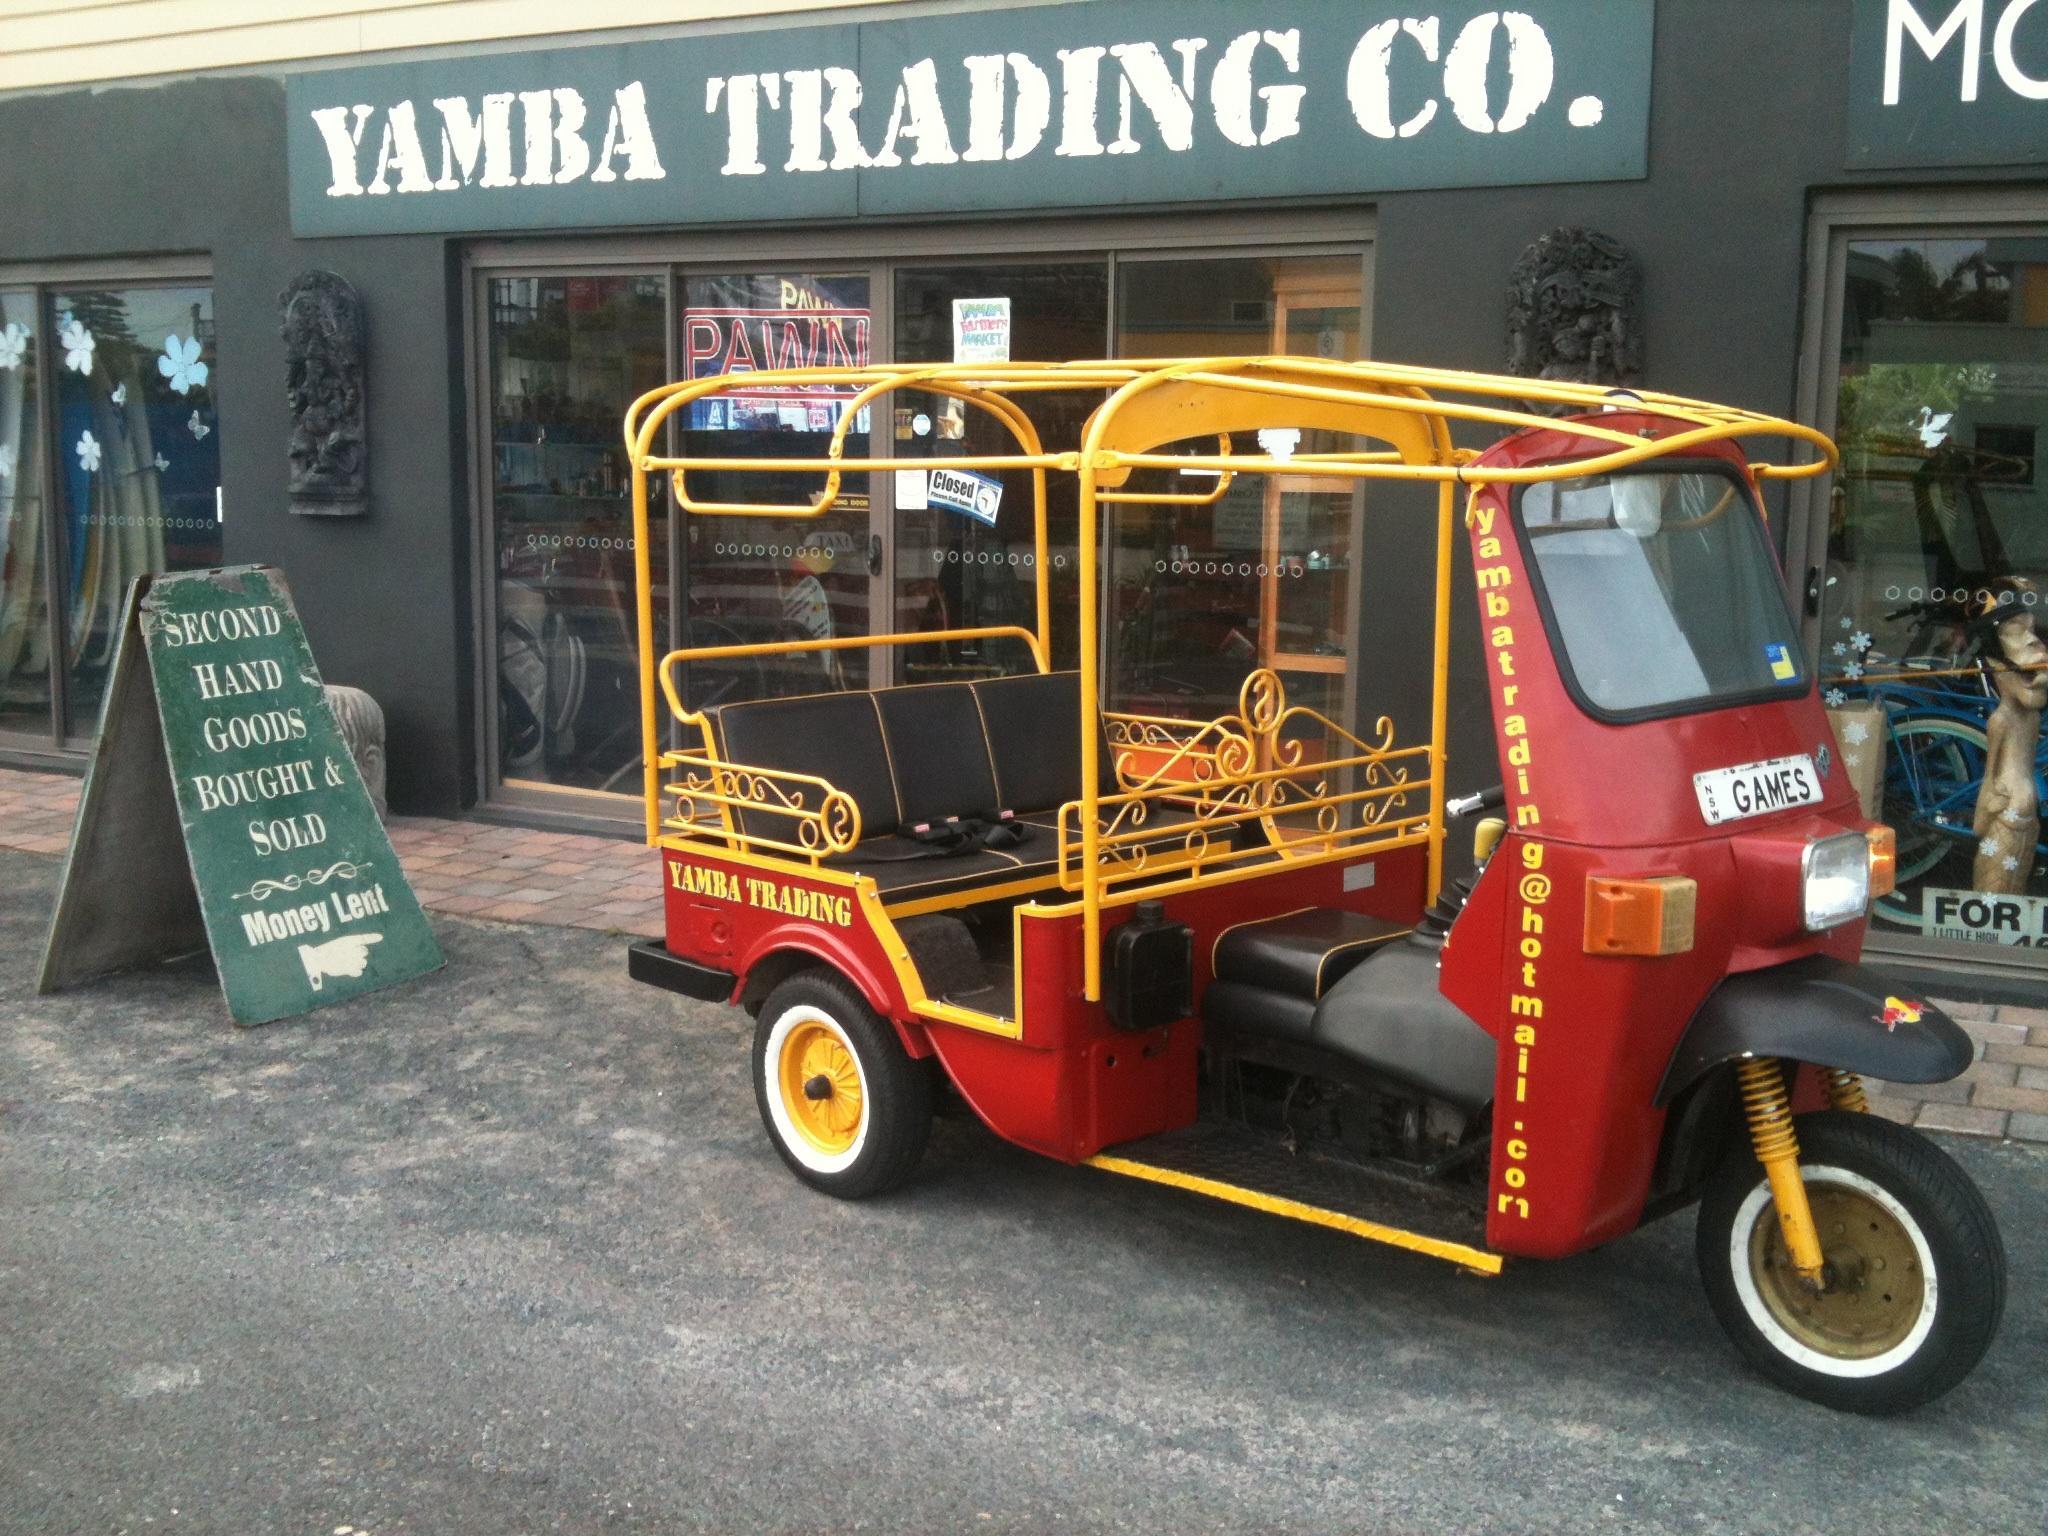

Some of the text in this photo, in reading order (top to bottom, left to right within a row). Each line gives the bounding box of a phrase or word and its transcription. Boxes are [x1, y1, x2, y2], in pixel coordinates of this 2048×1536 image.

[311, 10, 1604, 197] YAMBA TRADING CO.
[686, 319, 867, 391] PAWN
[933, 471, 975, 498] Closed
[163, 605, 281, 648] SECOND
[192, 659, 283, 700] HAND
[203, 707, 307, 753] GOODS
[191, 755, 345, 812] BOUGHT &
[1732, 768, 1811, 813] GAMES
[248, 812, 327, 857] SOLD
[240, 882, 390, 947] Money Lent
[668, 861, 852, 927] YAMBA TRADING
[1935, 896, 2021, 932] FOR
[1940, 928, 1973, 941] LITTLE
